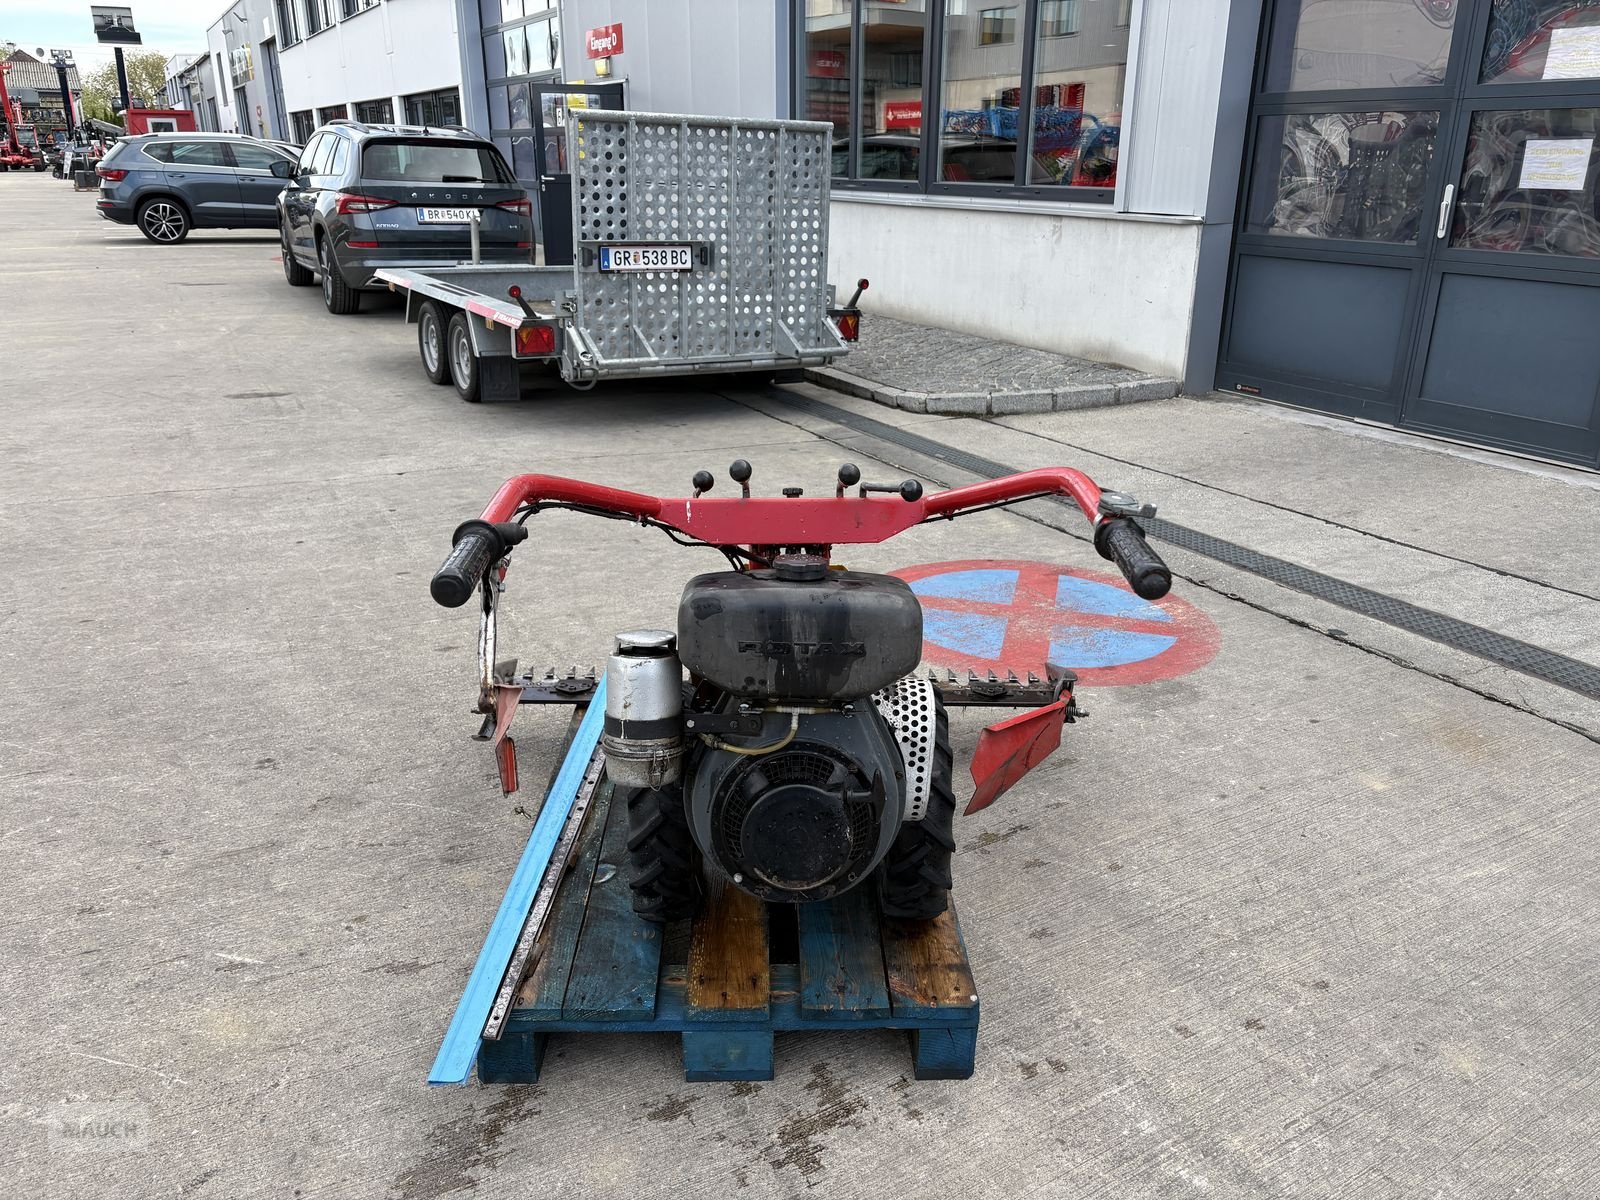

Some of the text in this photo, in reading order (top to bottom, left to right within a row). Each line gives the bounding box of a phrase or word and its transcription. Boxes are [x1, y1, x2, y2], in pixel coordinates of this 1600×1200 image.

[591, 36, 611, 51] Eingang
[428, 210, 440, 219] BR
[446, 210, 465, 219] 540
[614, 250, 687, 266] GR 538 BC
[738, 640, 866, 657] ROTAX
